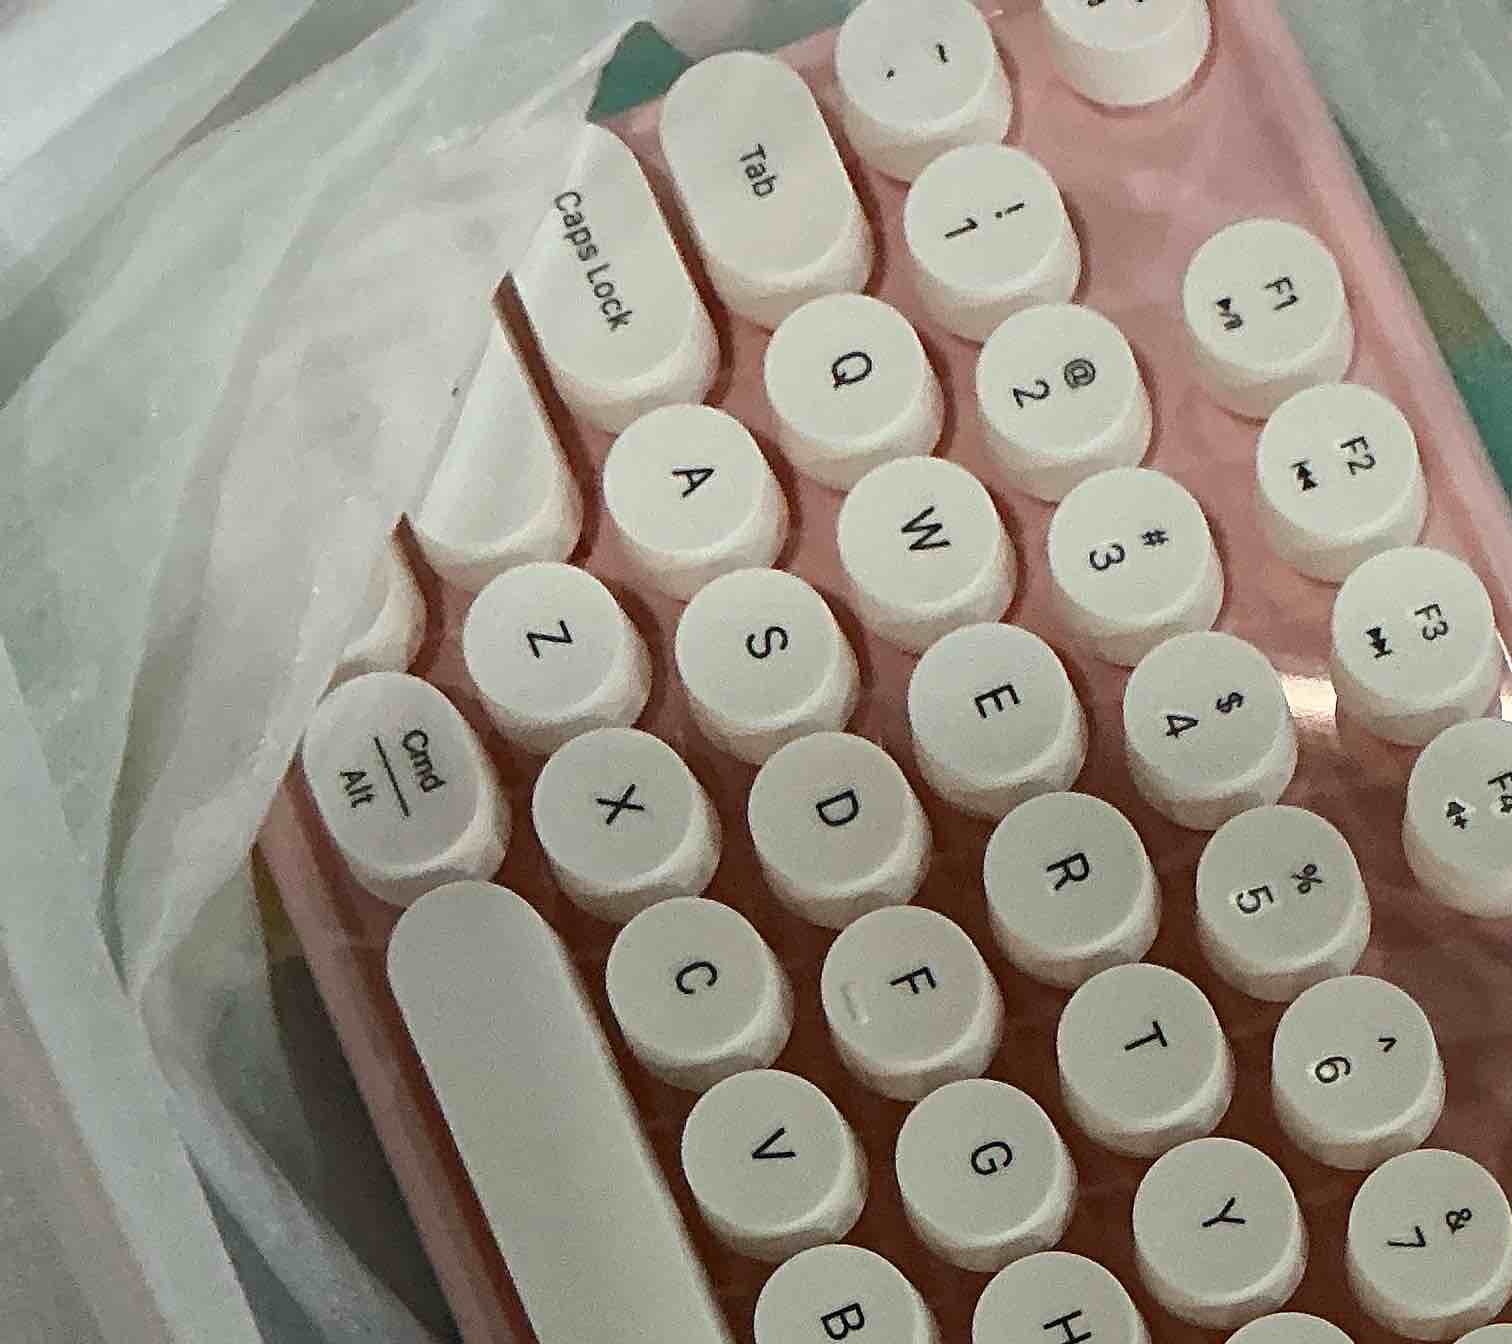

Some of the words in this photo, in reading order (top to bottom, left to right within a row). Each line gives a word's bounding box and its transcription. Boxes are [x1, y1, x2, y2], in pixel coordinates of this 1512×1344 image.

[740, 144, 776, 197] Tab
[945, 218, 978, 238] 1
[554, 192, 598, 261] Caps
[587, 264, 632, 331] Lock
[1265, 277, 1298, 310] F1
[832, 352, 872, 390] Q
[1064, 358, 1096, 390] @
[1013, 380, 1050, 408] 2
[1340, 436, 1376, 475] F2
[672, 468, 714, 497] A
[901, 506, 950, 551] W
[1142, 530, 1168, 546] #
[1090, 544, 1125, 571] 3
[1415, 604, 1448, 640] F3
[526, 620, 573, 658] Z
[746, 626, 788, 659] S
[974, 684, 1020, 718] E
[1216, 692, 1244, 713] $
[1166, 715, 1199, 738] 4
[402, 729, 446, 792] Cmd
[339, 771, 375, 808] Alt
[596, 784, 645, 825] X
[816, 789, 859, 827] D
[1046, 853, 1090, 891] R
[1291, 864, 1323, 894] %
[1236, 886, 1274, 914] 5
[675, 961, 718, 994] C
[890, 967, 936, 994] F
[1124, 1020, 1167, 1051] T
[1315, 1057, 1350, 1083] 6
[752, 1128, 796, 1159] V
[971, 1141, 1012, 1175] G
[1202, 1197, 1245, 1227] Y
[1446, 1208, 1472, 1234] &
[1387, 1226, 1426, 1247] 7
[821, 1303, 864, 1340] B
